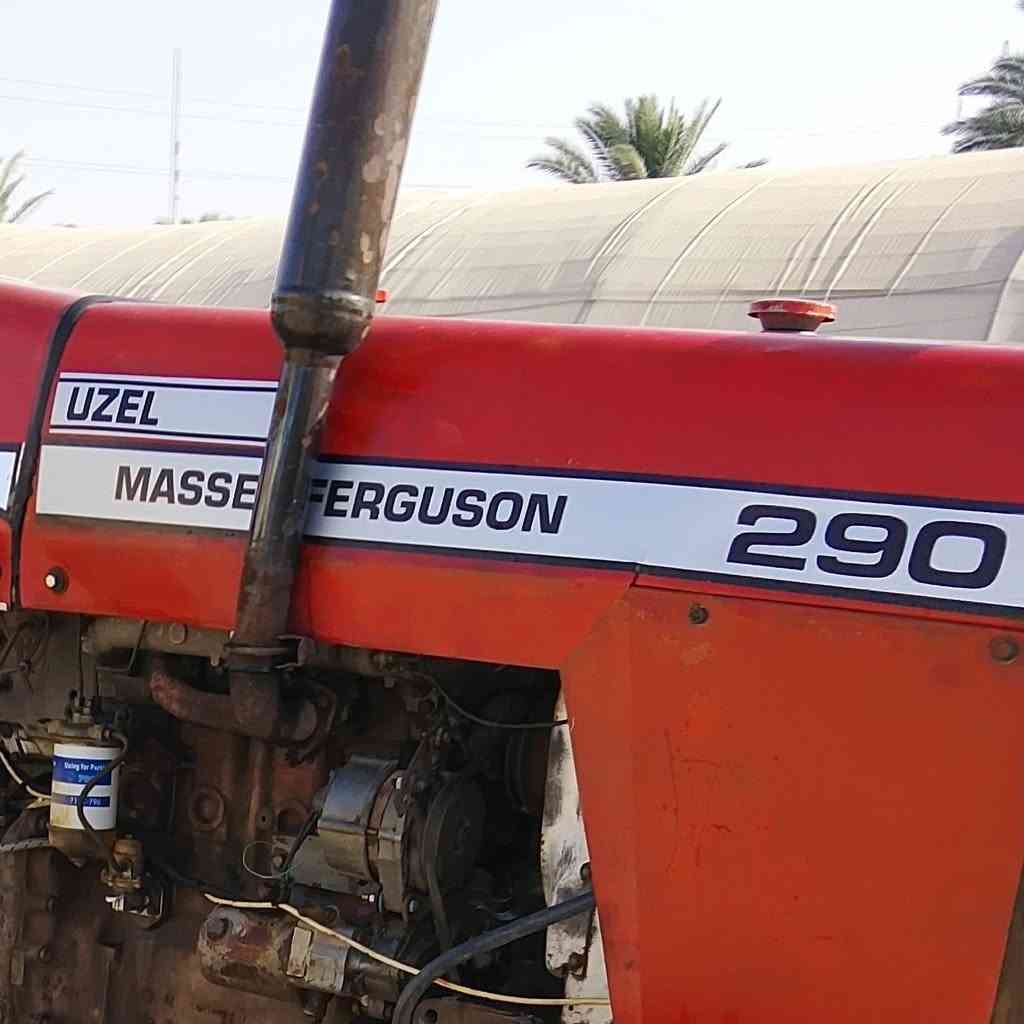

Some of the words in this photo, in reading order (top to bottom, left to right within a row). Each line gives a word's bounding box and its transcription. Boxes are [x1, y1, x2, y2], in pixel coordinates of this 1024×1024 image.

[66, 386, 158, 425] UZEL
[114, 465, 261, 510] MASSE
[726, 503, 1008, 589] 290
